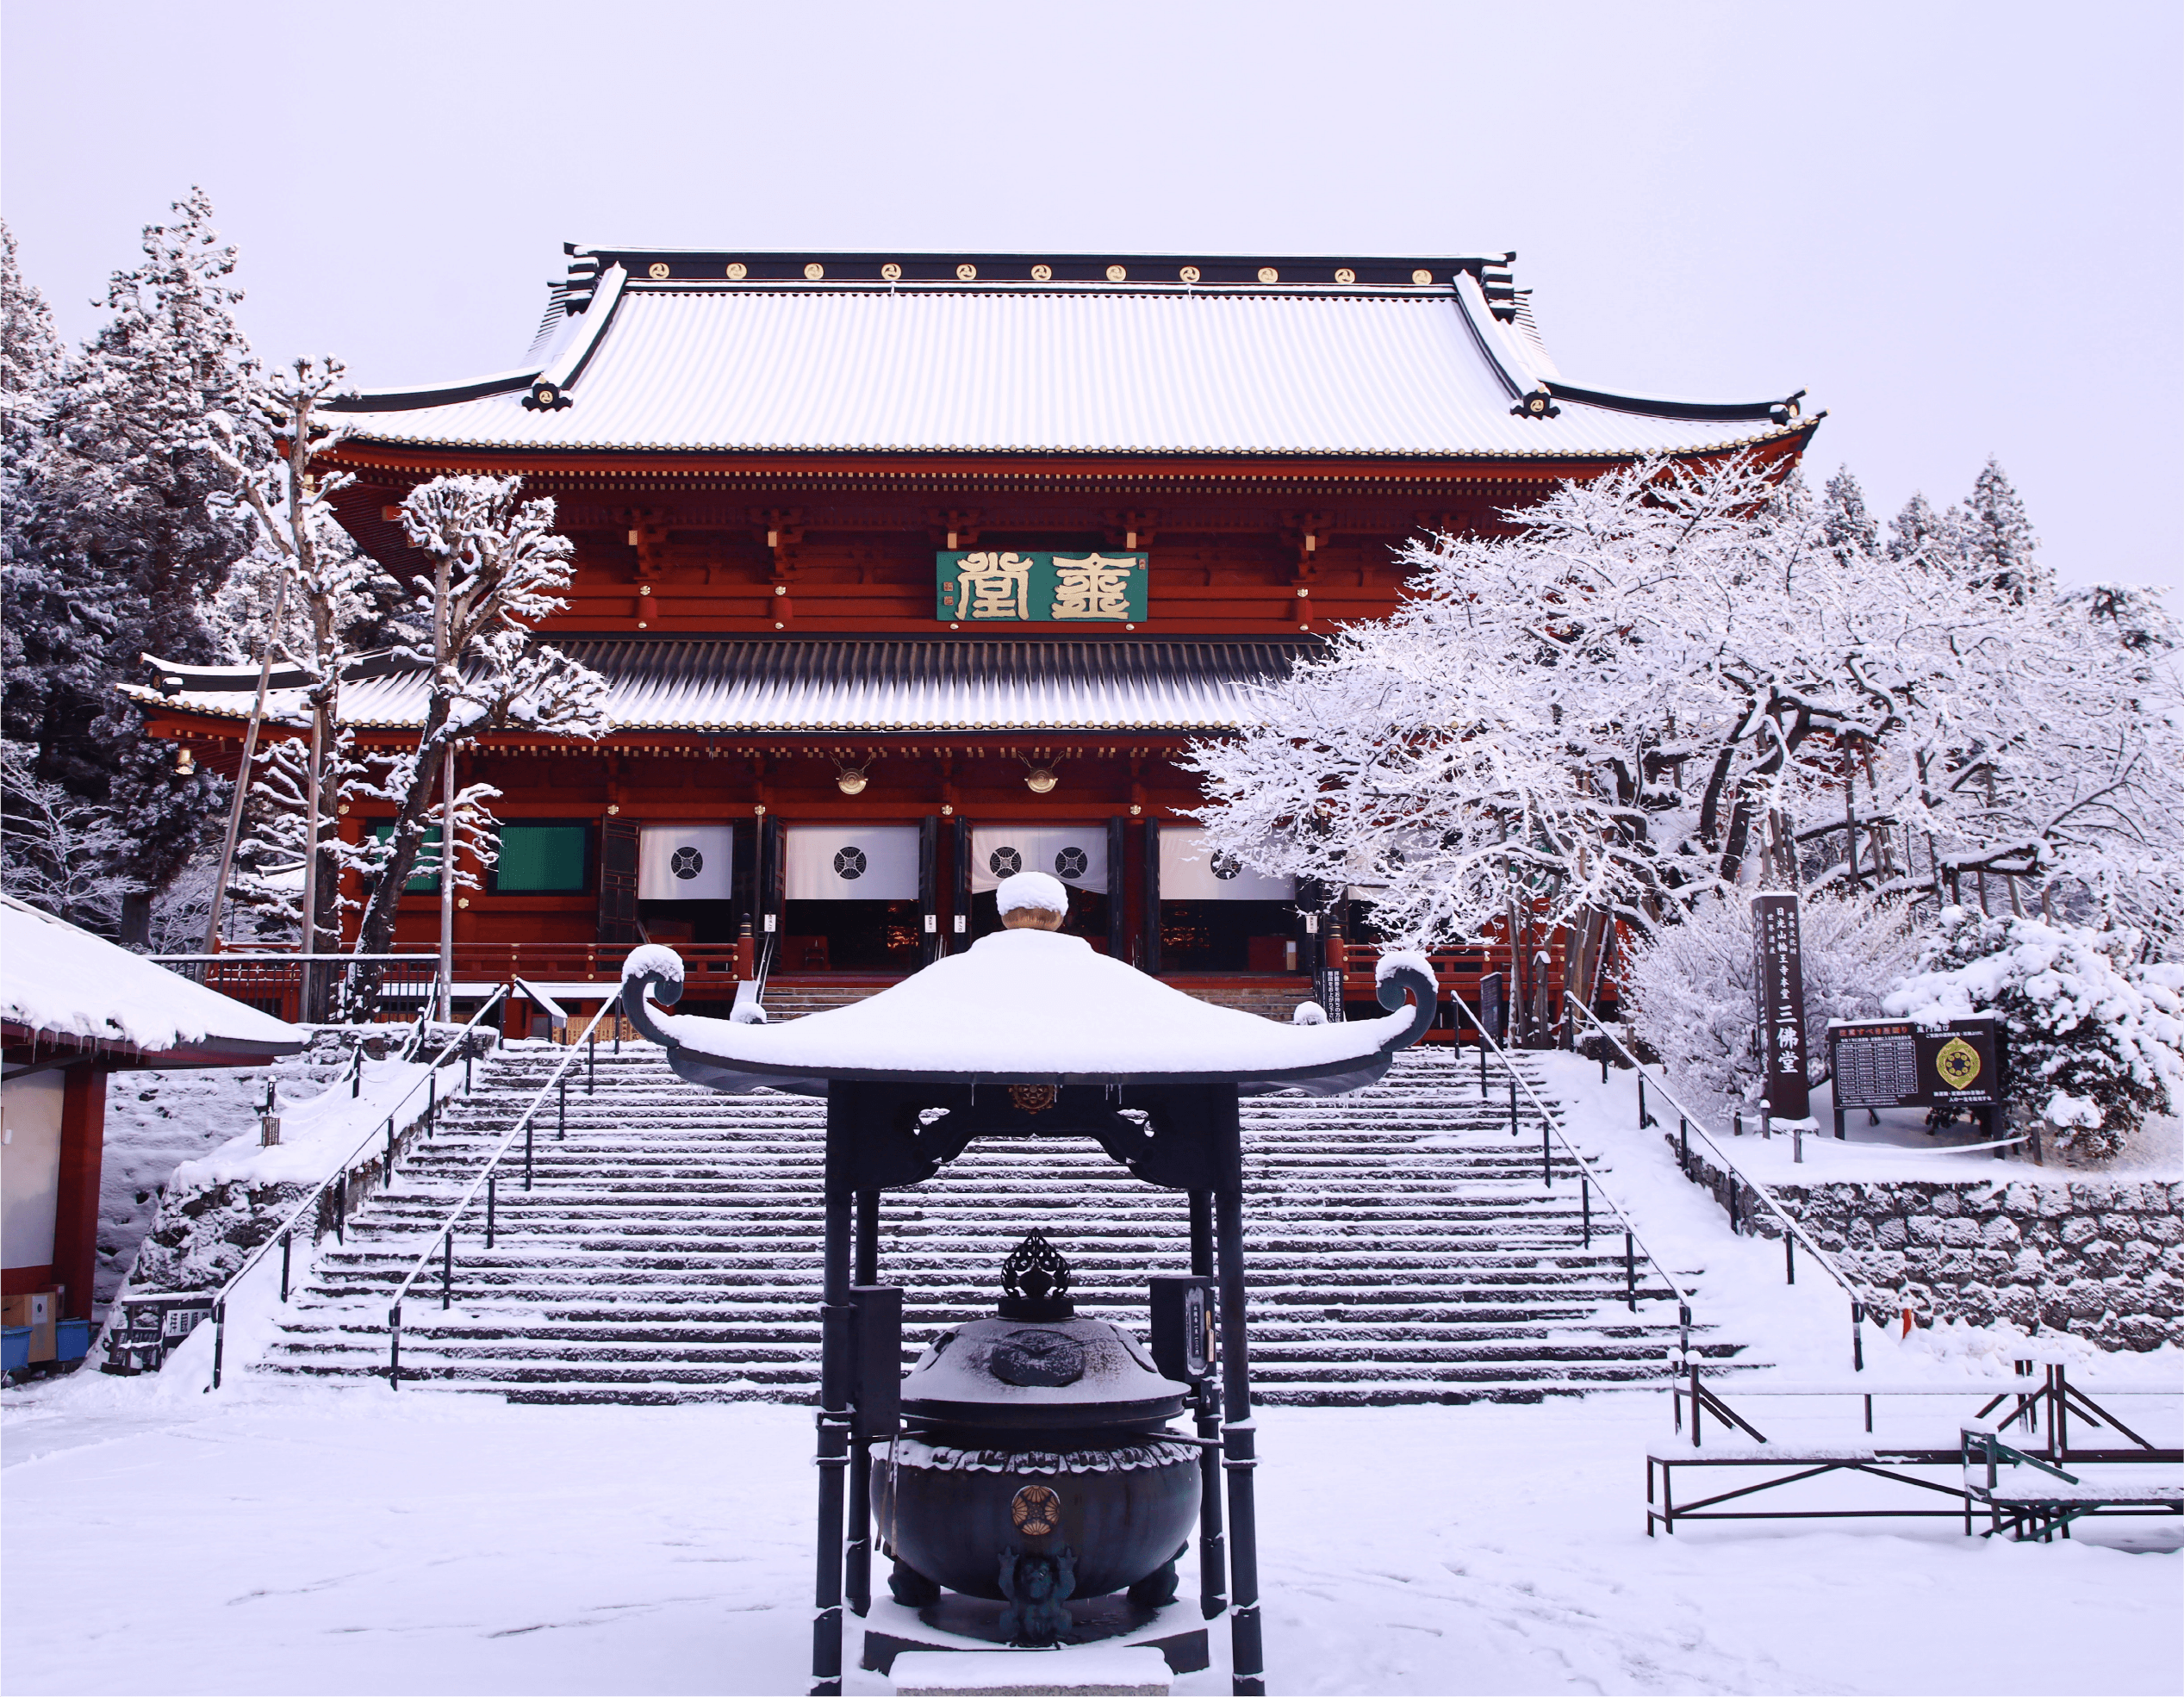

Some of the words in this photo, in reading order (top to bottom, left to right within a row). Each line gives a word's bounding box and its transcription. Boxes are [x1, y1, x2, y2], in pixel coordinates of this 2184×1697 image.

[1767, 913, 1776, 954] 世界遺産
[1776, 907, 1790, 1000] 日光山輪王寺本堂
[1787, 911, 1797, 955] 重要文化財
[1775, 1004, 1799, 1073] 三佛堂
